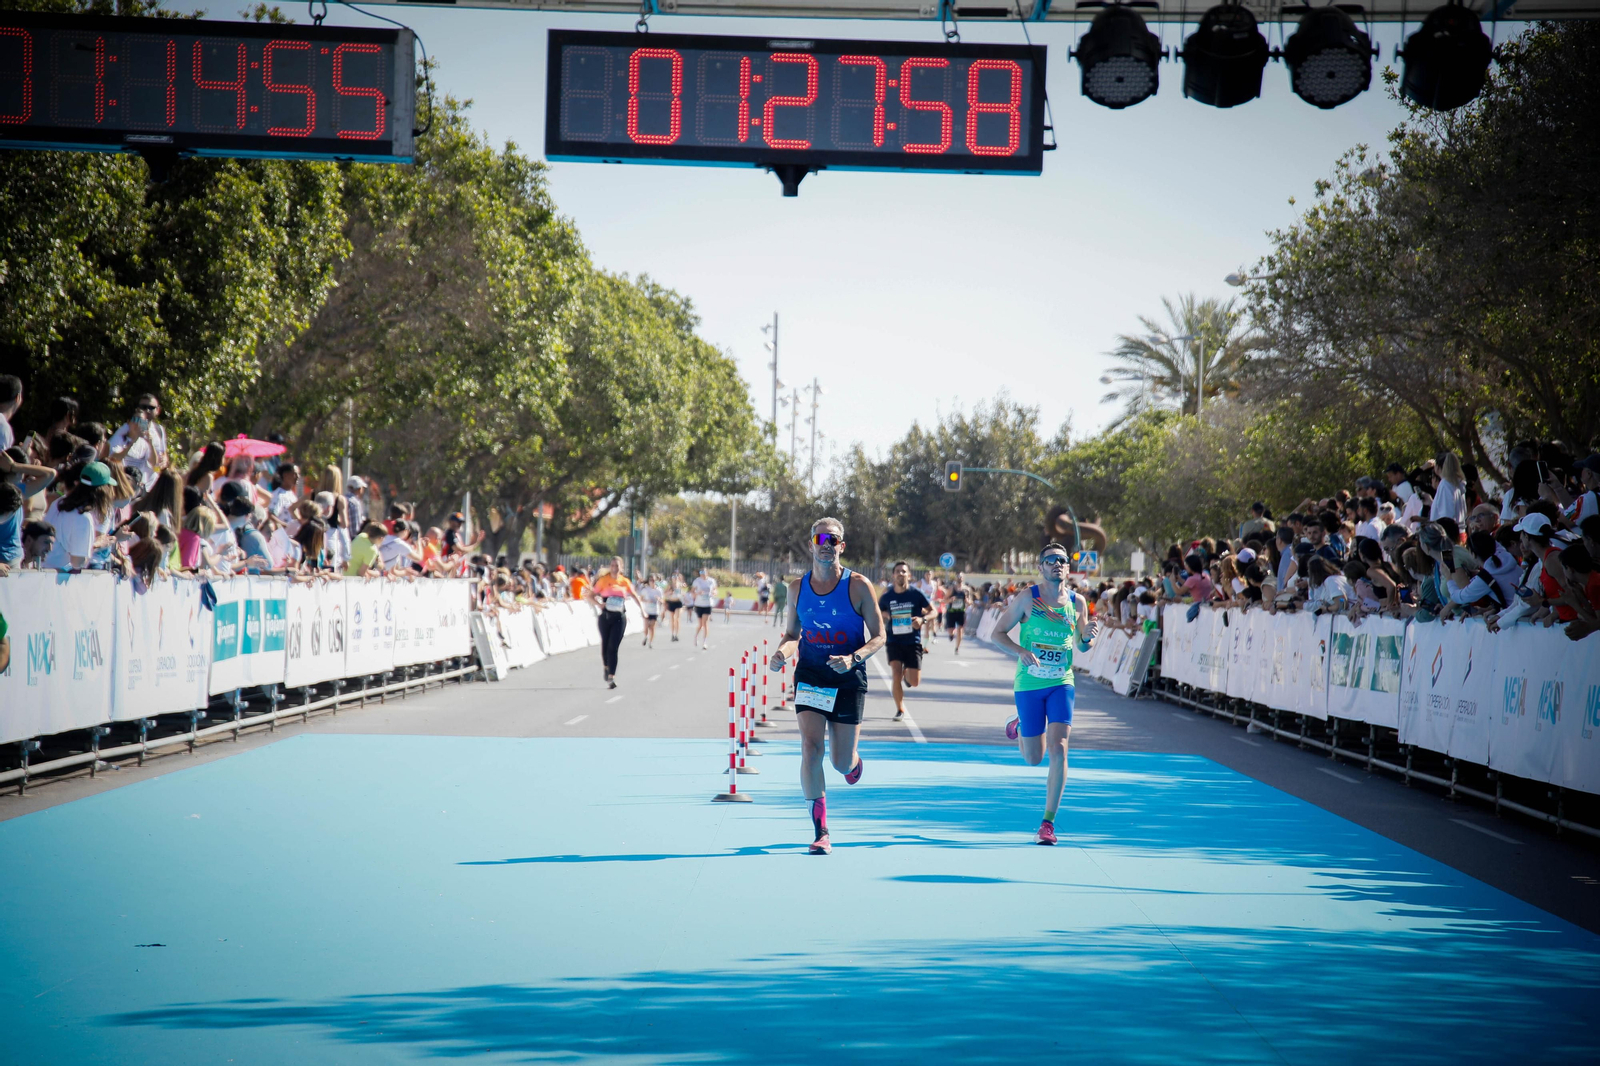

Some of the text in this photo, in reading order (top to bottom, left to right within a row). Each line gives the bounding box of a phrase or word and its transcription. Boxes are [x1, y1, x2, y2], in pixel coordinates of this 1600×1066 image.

[627, 47, 1023, 157] 01:27:58
[806, 629, 848, 645] GALO
[1038, 649, 1062, 662] 295
